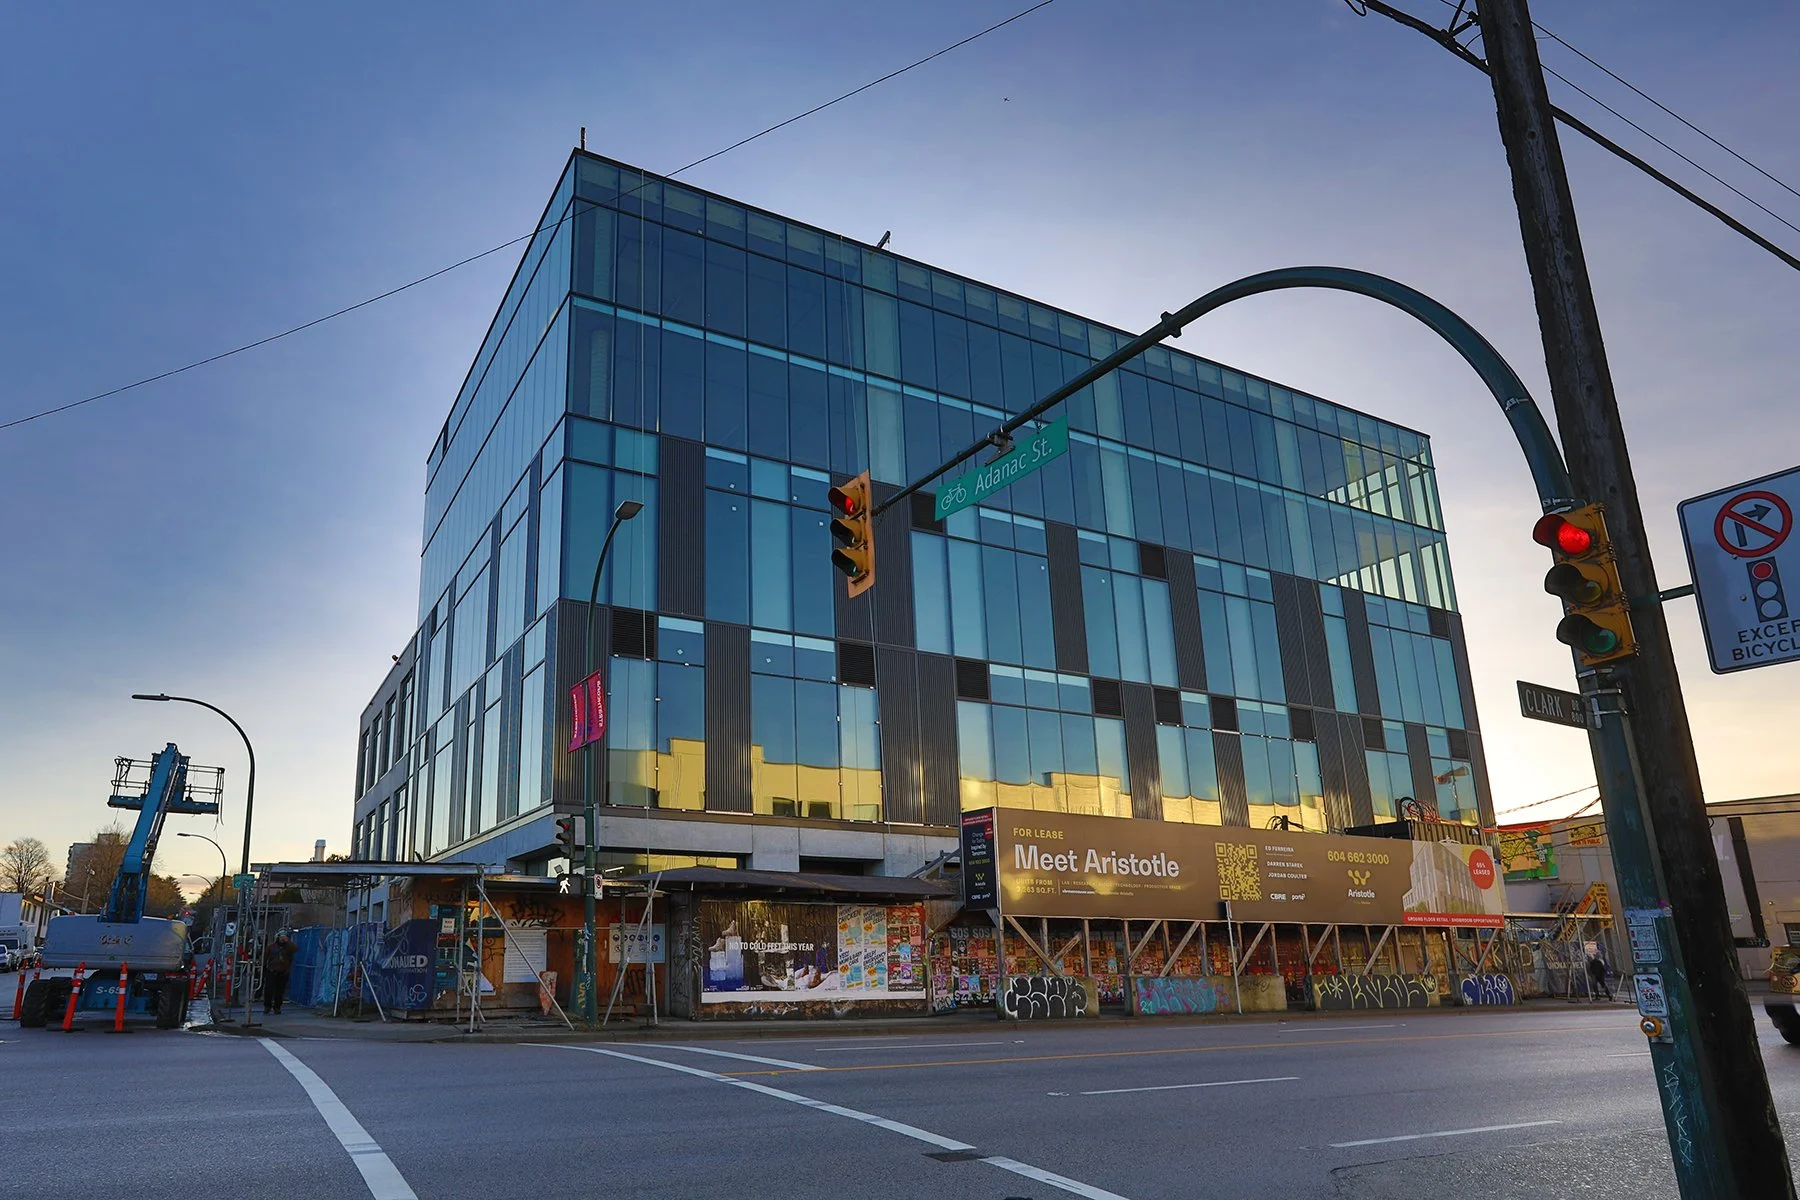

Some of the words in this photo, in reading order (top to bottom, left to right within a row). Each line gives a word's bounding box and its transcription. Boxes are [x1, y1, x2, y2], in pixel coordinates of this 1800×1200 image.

[974, 453, 1027, 495] Adanac
[1031, 438, 1053, 463] St.
[1525, 688, 1564, 718] CLARK
[1013, 828, 1032, 837] FOR
[1034, 829, 1064, 840] LEASE
[1014, 844, 1078, 872] Meet
[1084, 848, 1180, 878] Aristotle
[1327, 850, 1346, 862] 604
[1347, 851, 1366, 864] 662
[1366, 852, 1390, 865] 3000
[1348, 888, 1376, 898] Aristotle
[951, 927, 969, 938] SOS
[972, 928, 991, 938] SOS
[729, 942, 739, 950] NO
[740, 942, 748, 950] TO
[749, 942, 766, 951] COLD
[767, 942, 781, 951] FEET
[781, 942, 798, 951] THIS
[798, 943, 814, 951] YEAR
